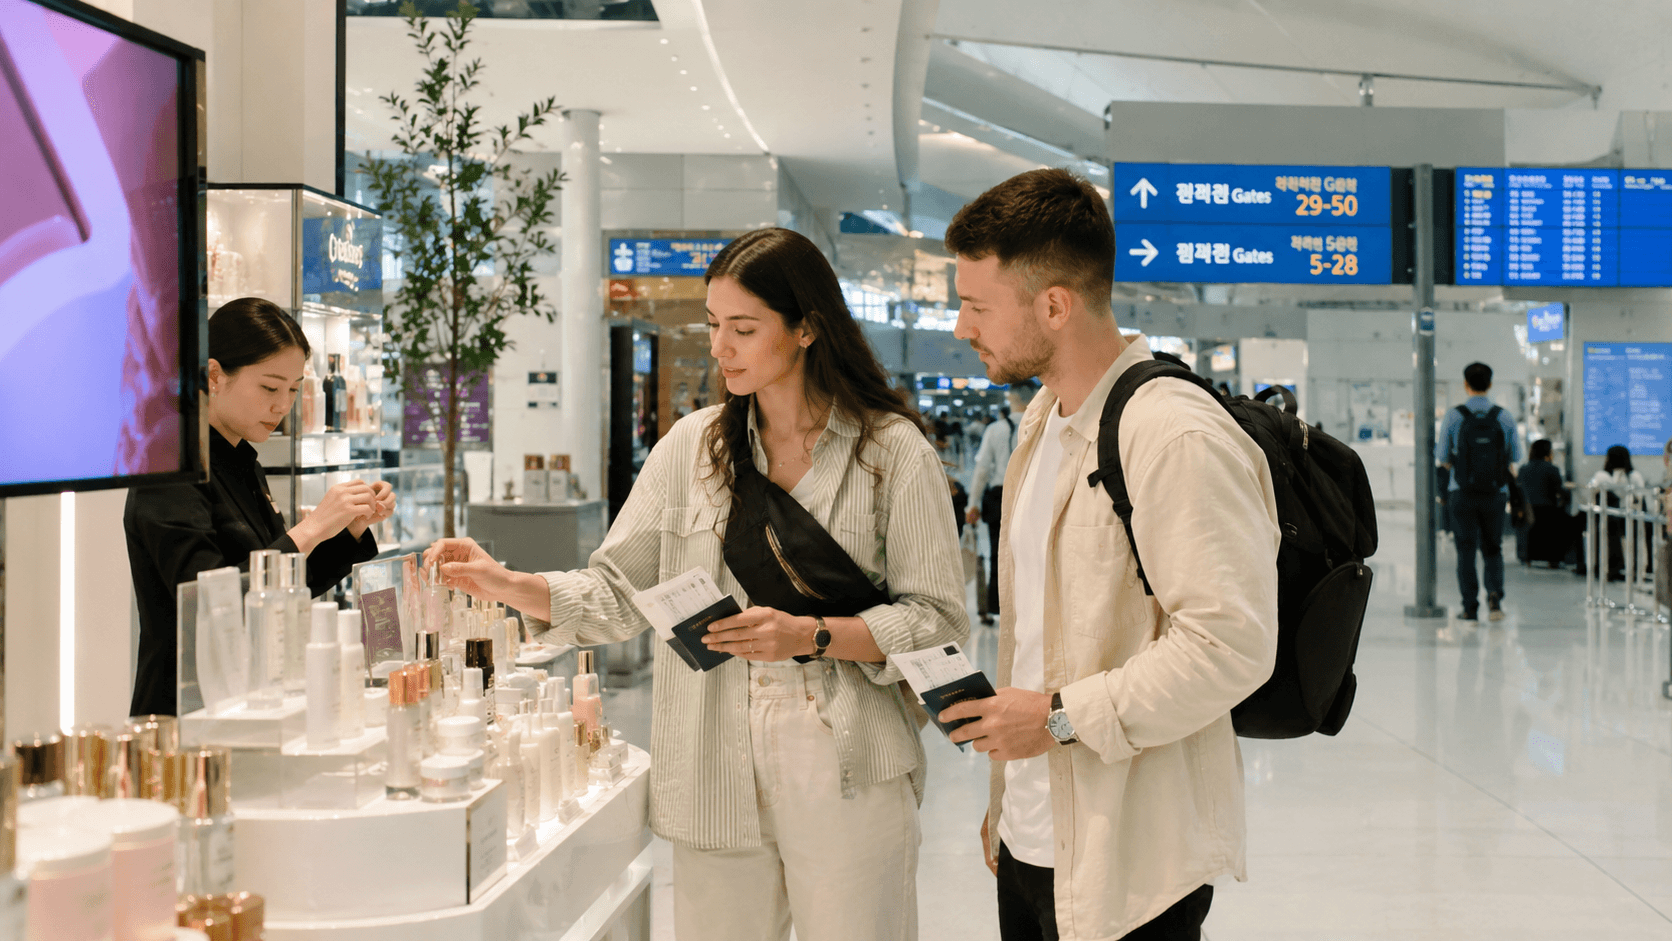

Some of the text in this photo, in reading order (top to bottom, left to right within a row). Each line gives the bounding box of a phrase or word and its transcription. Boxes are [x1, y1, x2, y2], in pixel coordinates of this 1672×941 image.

[1231, 187, 1272, 204] Gates
[1295, 194, 1358, 217] 29-50
[1232, 247, 1274, 264] Gates
[1310, 253, 1359, 276] 5-28
